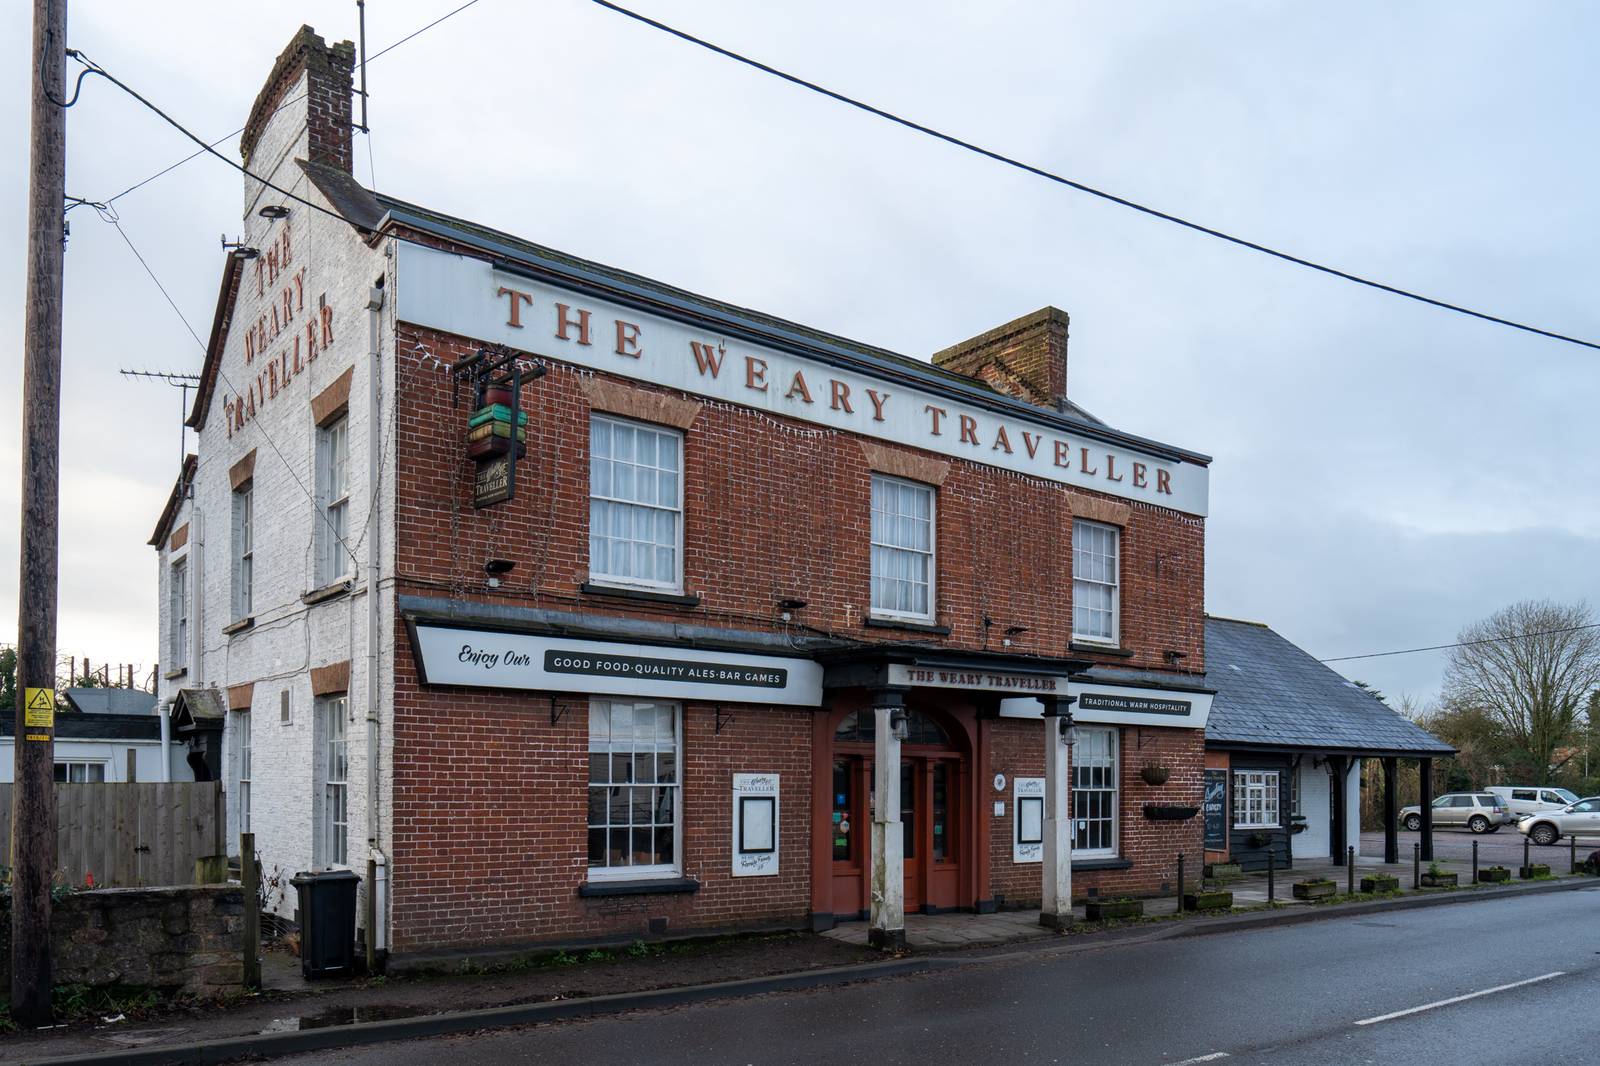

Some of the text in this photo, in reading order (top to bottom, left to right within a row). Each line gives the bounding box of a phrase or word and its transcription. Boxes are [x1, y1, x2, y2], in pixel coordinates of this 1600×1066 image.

[255, 224, 292, 298] THE
[244, 266, 307, 366] WEARY
[224, 305, 335, 439] TRAVELLER
[497, 286, 1173, 495] THE WEARY TRAVELLER
[475, 476, 508, 495] TRAVELLER
[458, 644, 499, 669] Enjoy
[503, 650, 530, 666] Our
[553, 657, 591, 669] GOOD
[744, 672, 781, 683] GAMES
[907, 669, 1057, 691] THE WEARY TRAVELLER
[1084, 698, 1188, 712] TRADITIONAL WARM HOSPITALITY
